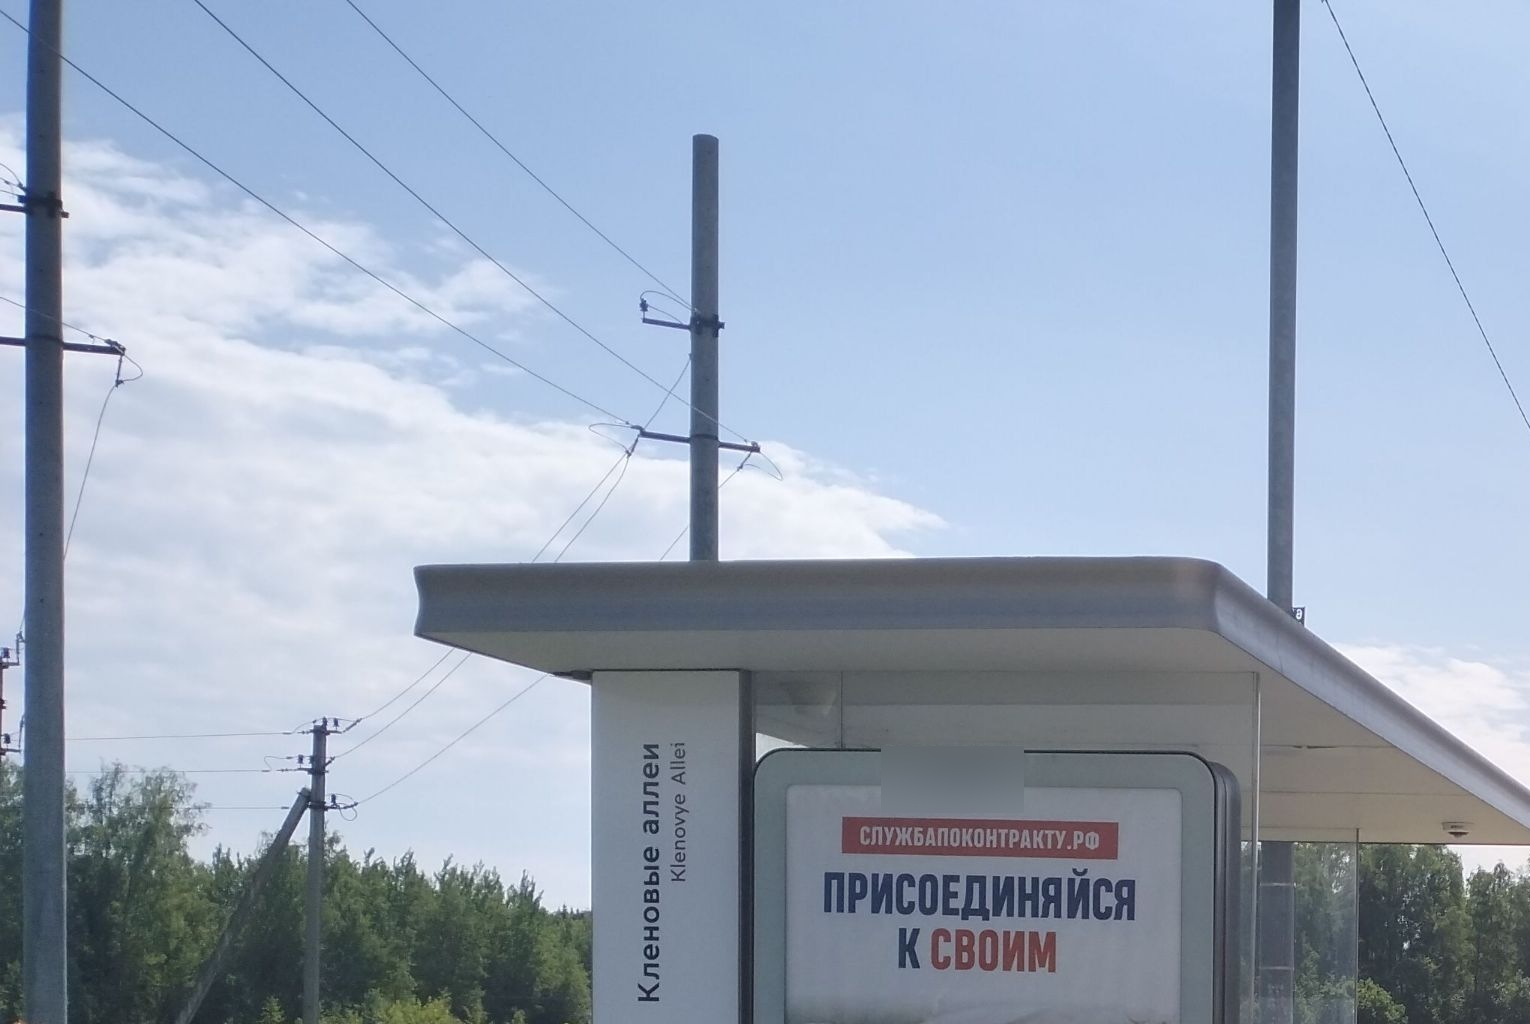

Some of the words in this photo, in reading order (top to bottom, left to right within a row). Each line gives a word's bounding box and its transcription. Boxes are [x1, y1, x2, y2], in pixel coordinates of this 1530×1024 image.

[643, 743, 660, 835] аллеи
[670, 742, 686, 785] Allei
[670, 793, 690, 882] Klenovye
[859, 825, 1100, 850] СЛУЖБАПОКОНТРАКТУ.РФ
[823, 867, 1136, 921] ПРИСОЕДИНЯЙСЯ
[637, 846, 660, 1002] Кленовые
[898, 927, 921, 969] К
[930, 927, 1057, 973] СВОИМ
